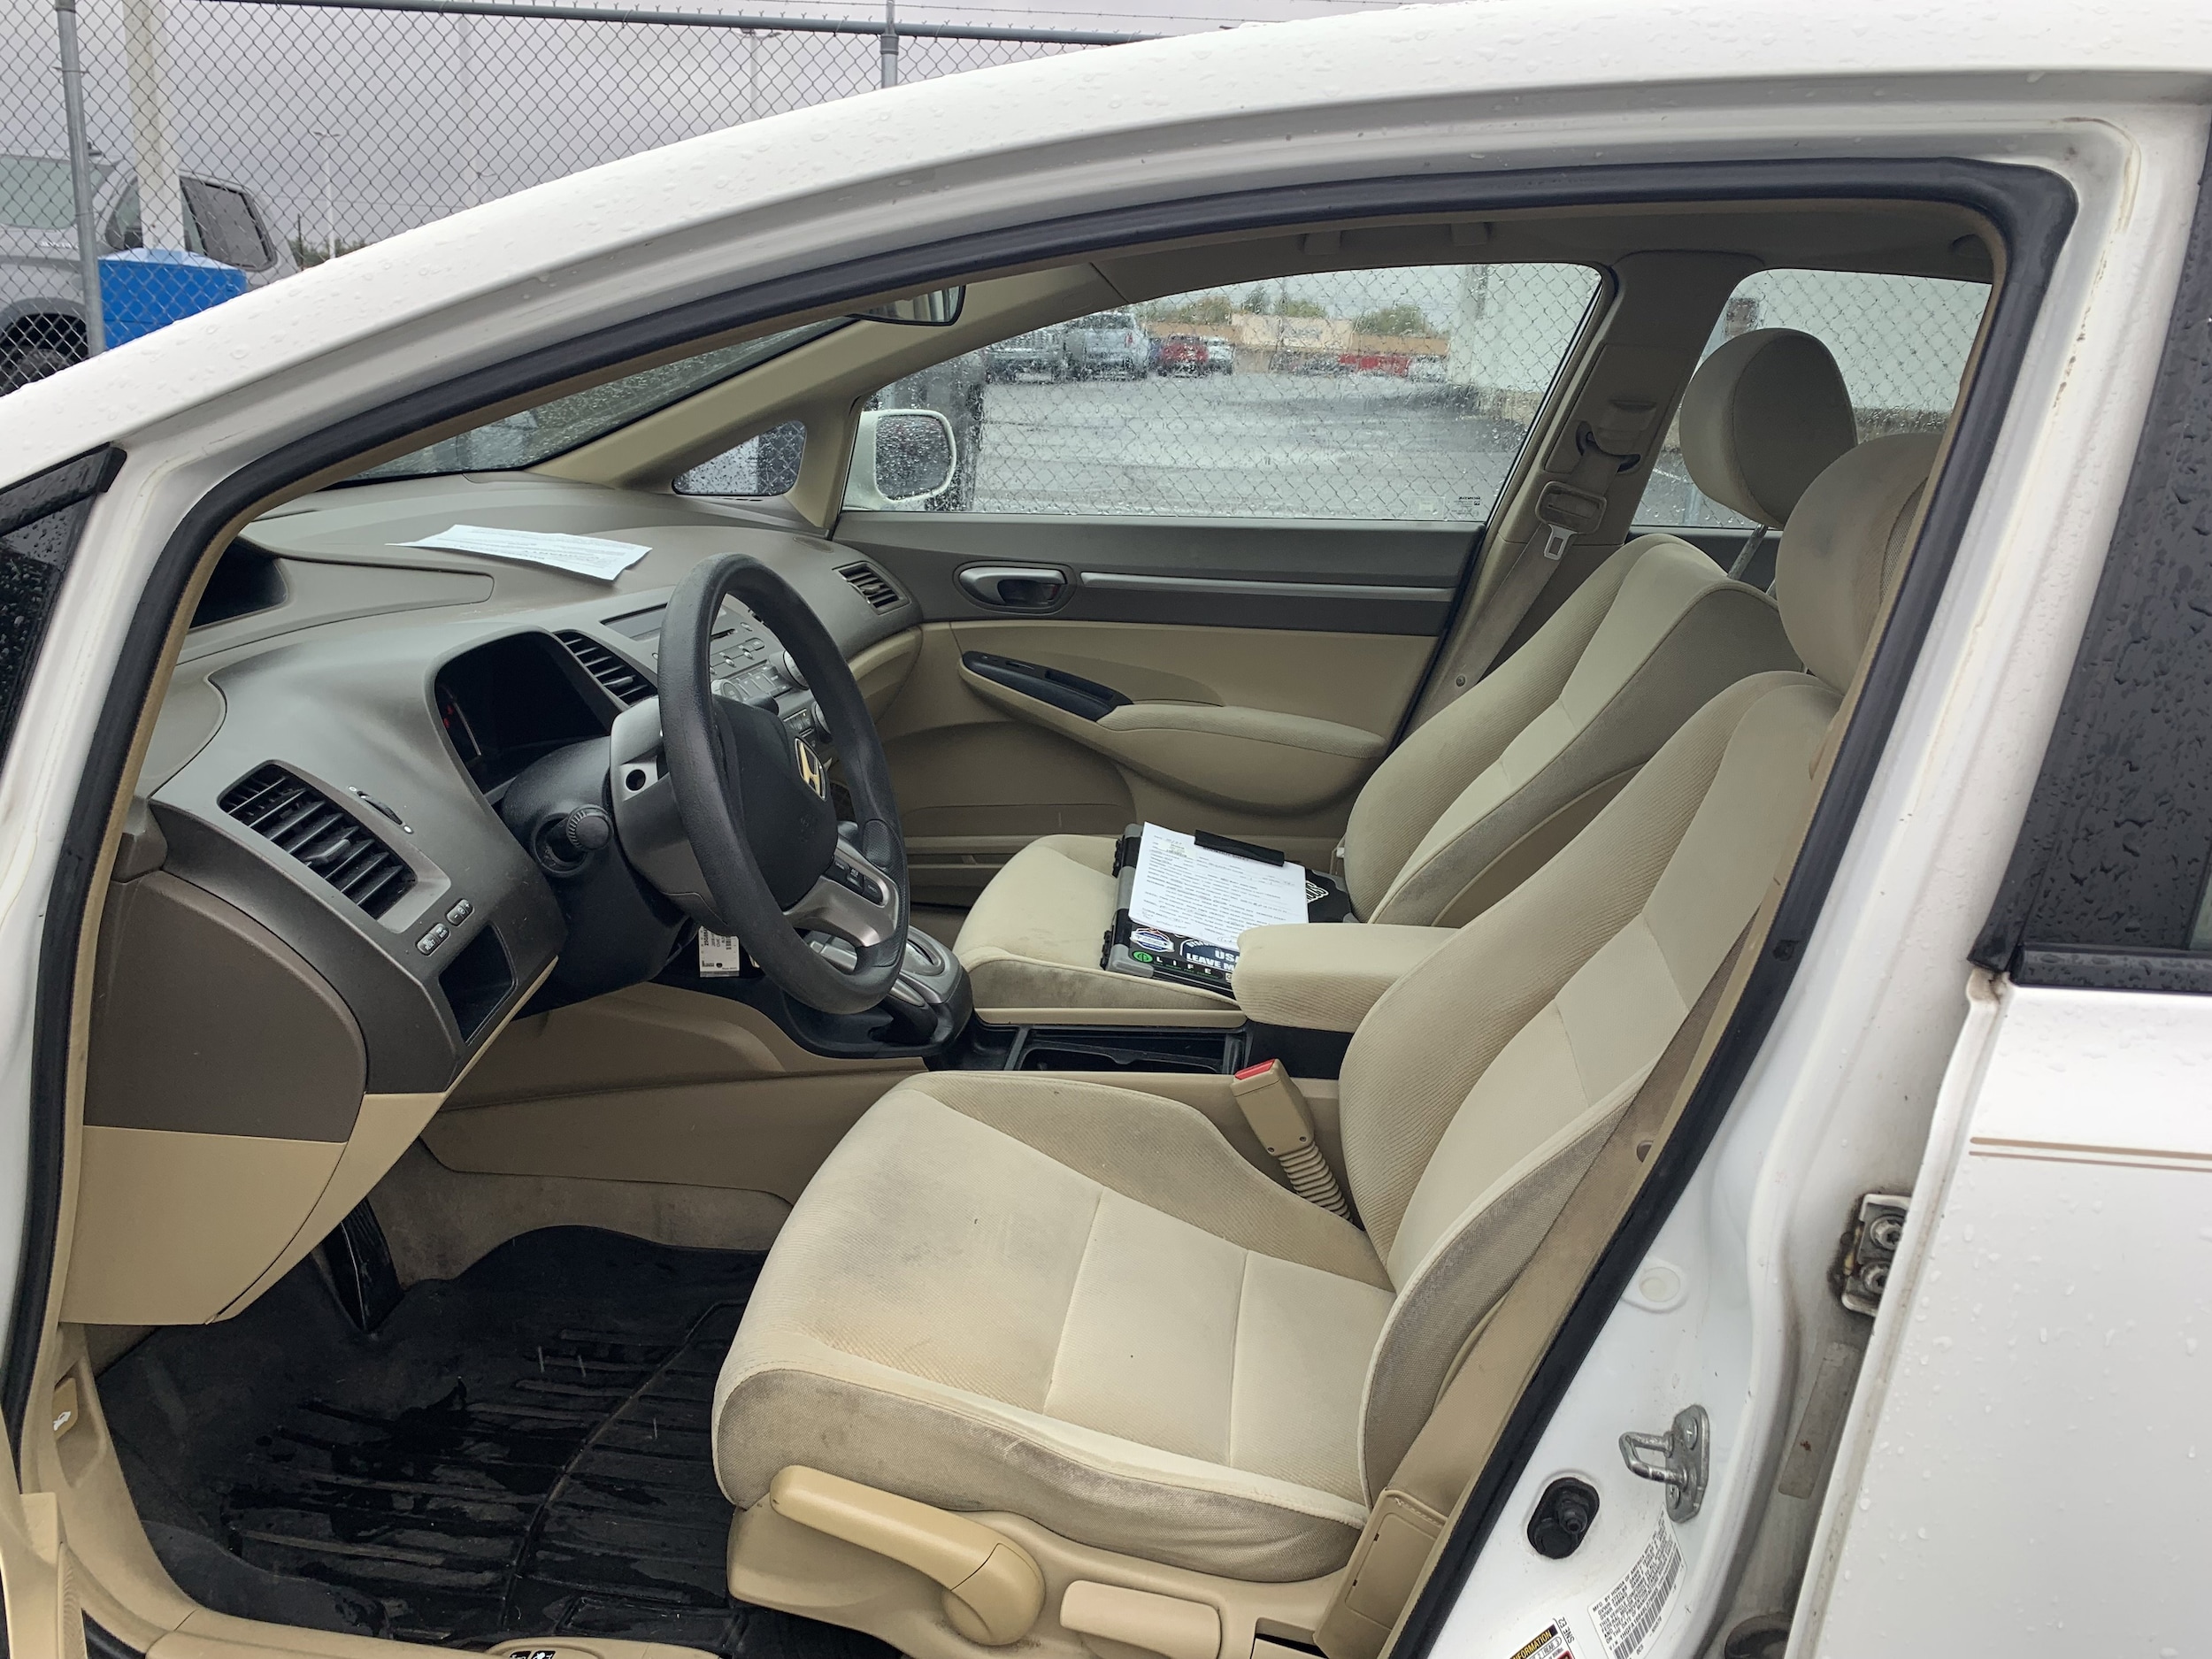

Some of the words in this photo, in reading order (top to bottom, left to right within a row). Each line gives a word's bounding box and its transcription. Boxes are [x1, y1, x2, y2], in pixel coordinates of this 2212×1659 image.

[1187, 953, 1221, 967] LEAVE
[1603, 1594, 1610, 1602] BY
[1610, 1580, 1624, 1596] HONDA
[1599, 1617, 1609, 1628] THIS
[1609, 1601, 1625, 1618] VEHICLE
[1601, 1615, 1618, 1633] FEDERAL
[1620, 1599, 1633, 1616] MOTOR
[1604, 1627, 1613, 1638] AND
[1613, 1613, 1625, 1629] THEFT
[1625, 1588, 1647, 1616] PREVENTION
[1621, 1616, 1631, 1628] DATE
[1512, 1630, 1552, 1659] NFORMATION
